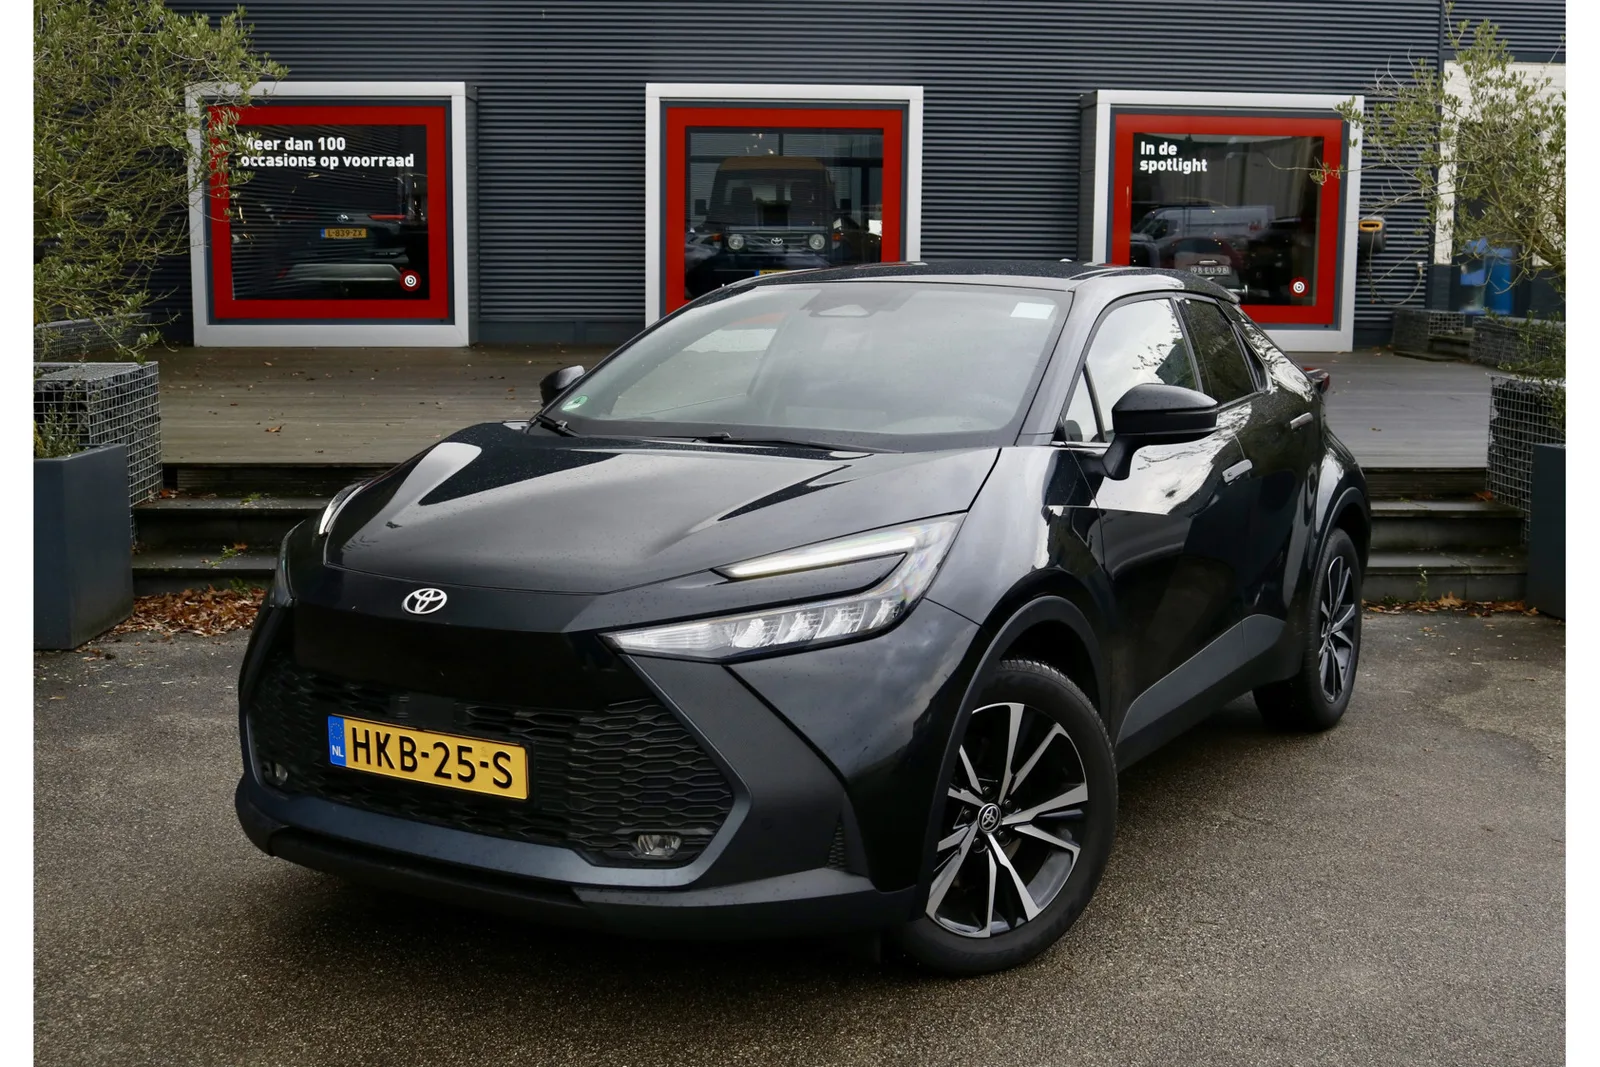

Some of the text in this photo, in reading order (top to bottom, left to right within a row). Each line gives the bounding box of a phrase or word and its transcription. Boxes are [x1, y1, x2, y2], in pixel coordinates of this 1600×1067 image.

[284, 136, 313, 151] dan
[318, 136, 346, 151] 100
[1140, 141, 1178, 156] In de
[240, 153, 414, 170] occasions op voorraad
[1139, 158, 1208, 175] spotlight
[331, 744, 344, 758] NL
[352, 727, 513, 789] HKB-25-S
